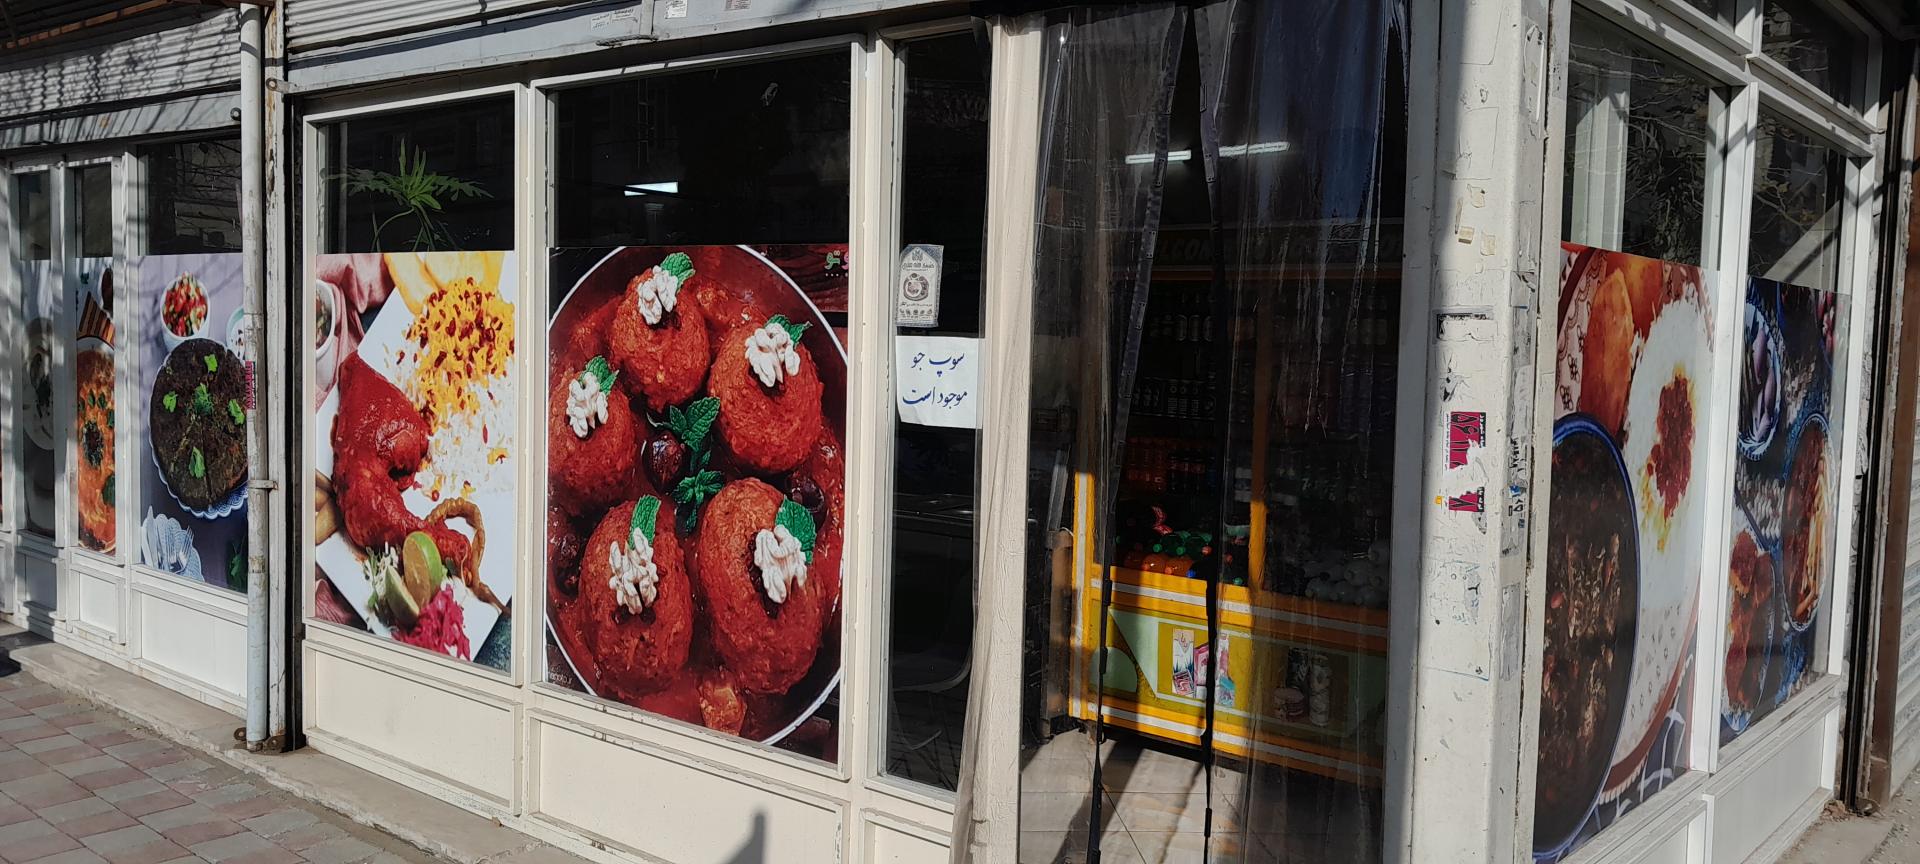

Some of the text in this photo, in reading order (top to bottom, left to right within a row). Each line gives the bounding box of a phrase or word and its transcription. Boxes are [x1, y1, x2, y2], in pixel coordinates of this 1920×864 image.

[910, 352, 965, 378] سوپ جو
[902, 386, 968, 410] موجود است
